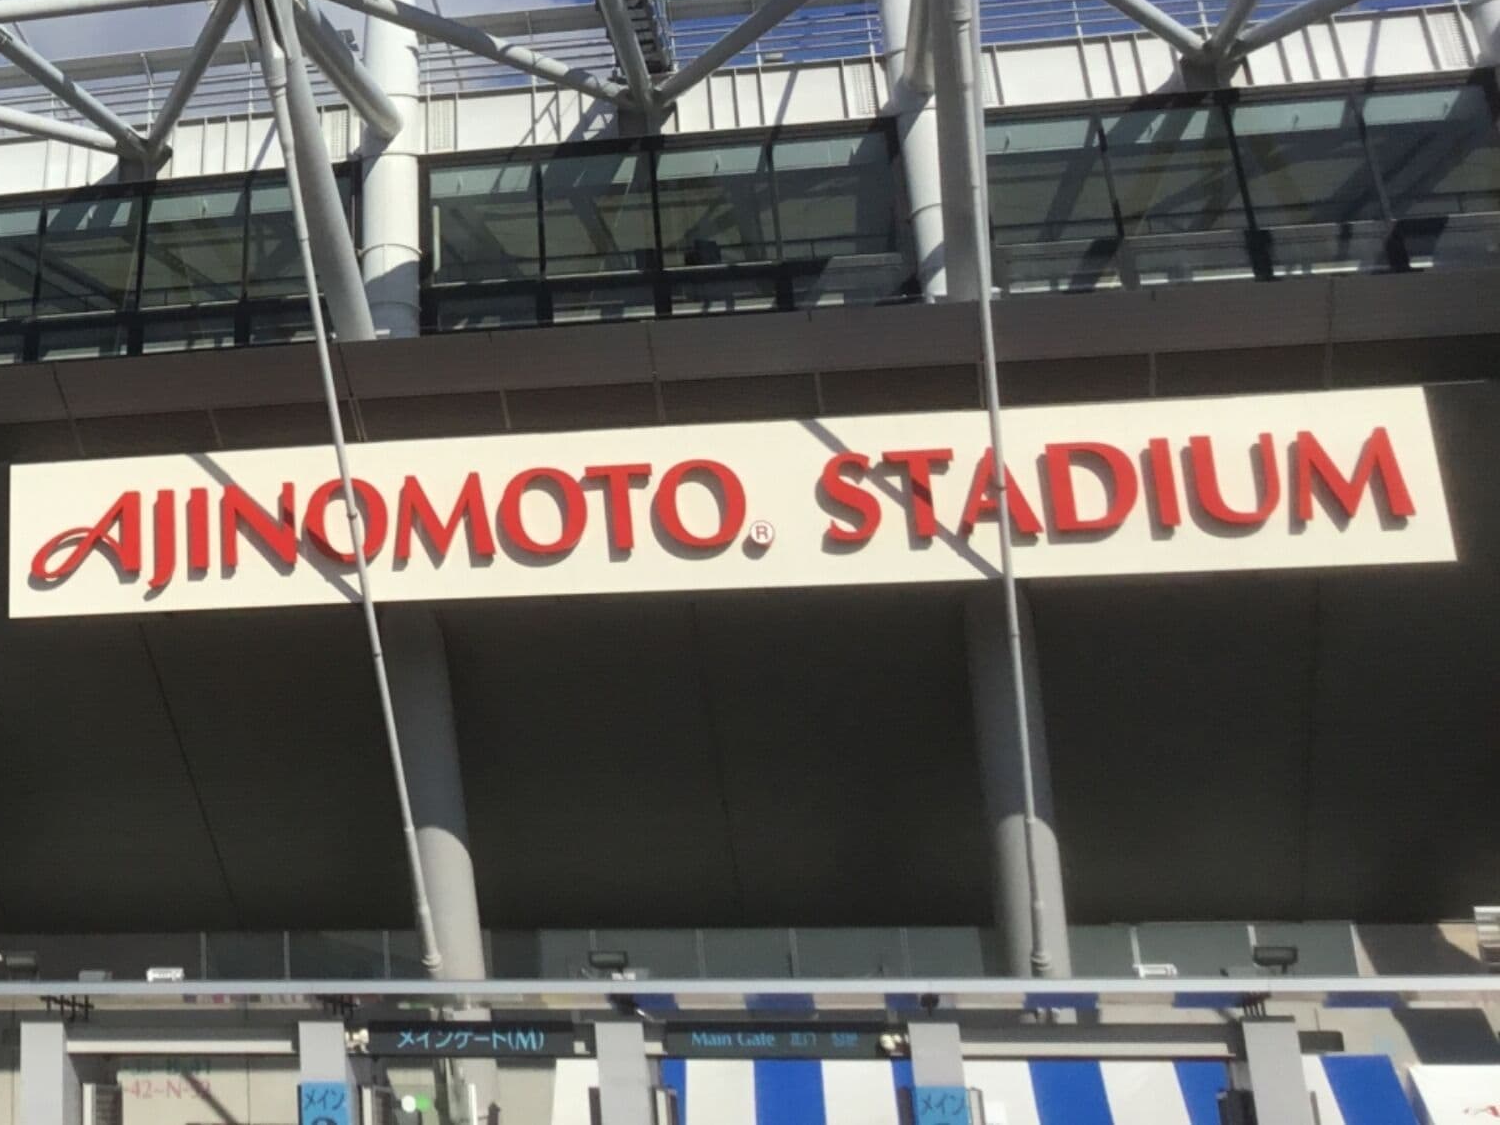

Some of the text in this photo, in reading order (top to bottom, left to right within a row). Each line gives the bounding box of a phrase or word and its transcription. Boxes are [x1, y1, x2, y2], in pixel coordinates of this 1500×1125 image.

[817, 426, 1416, 550] STADIUM
[691, 1031, 776, 1047] Main Gate
